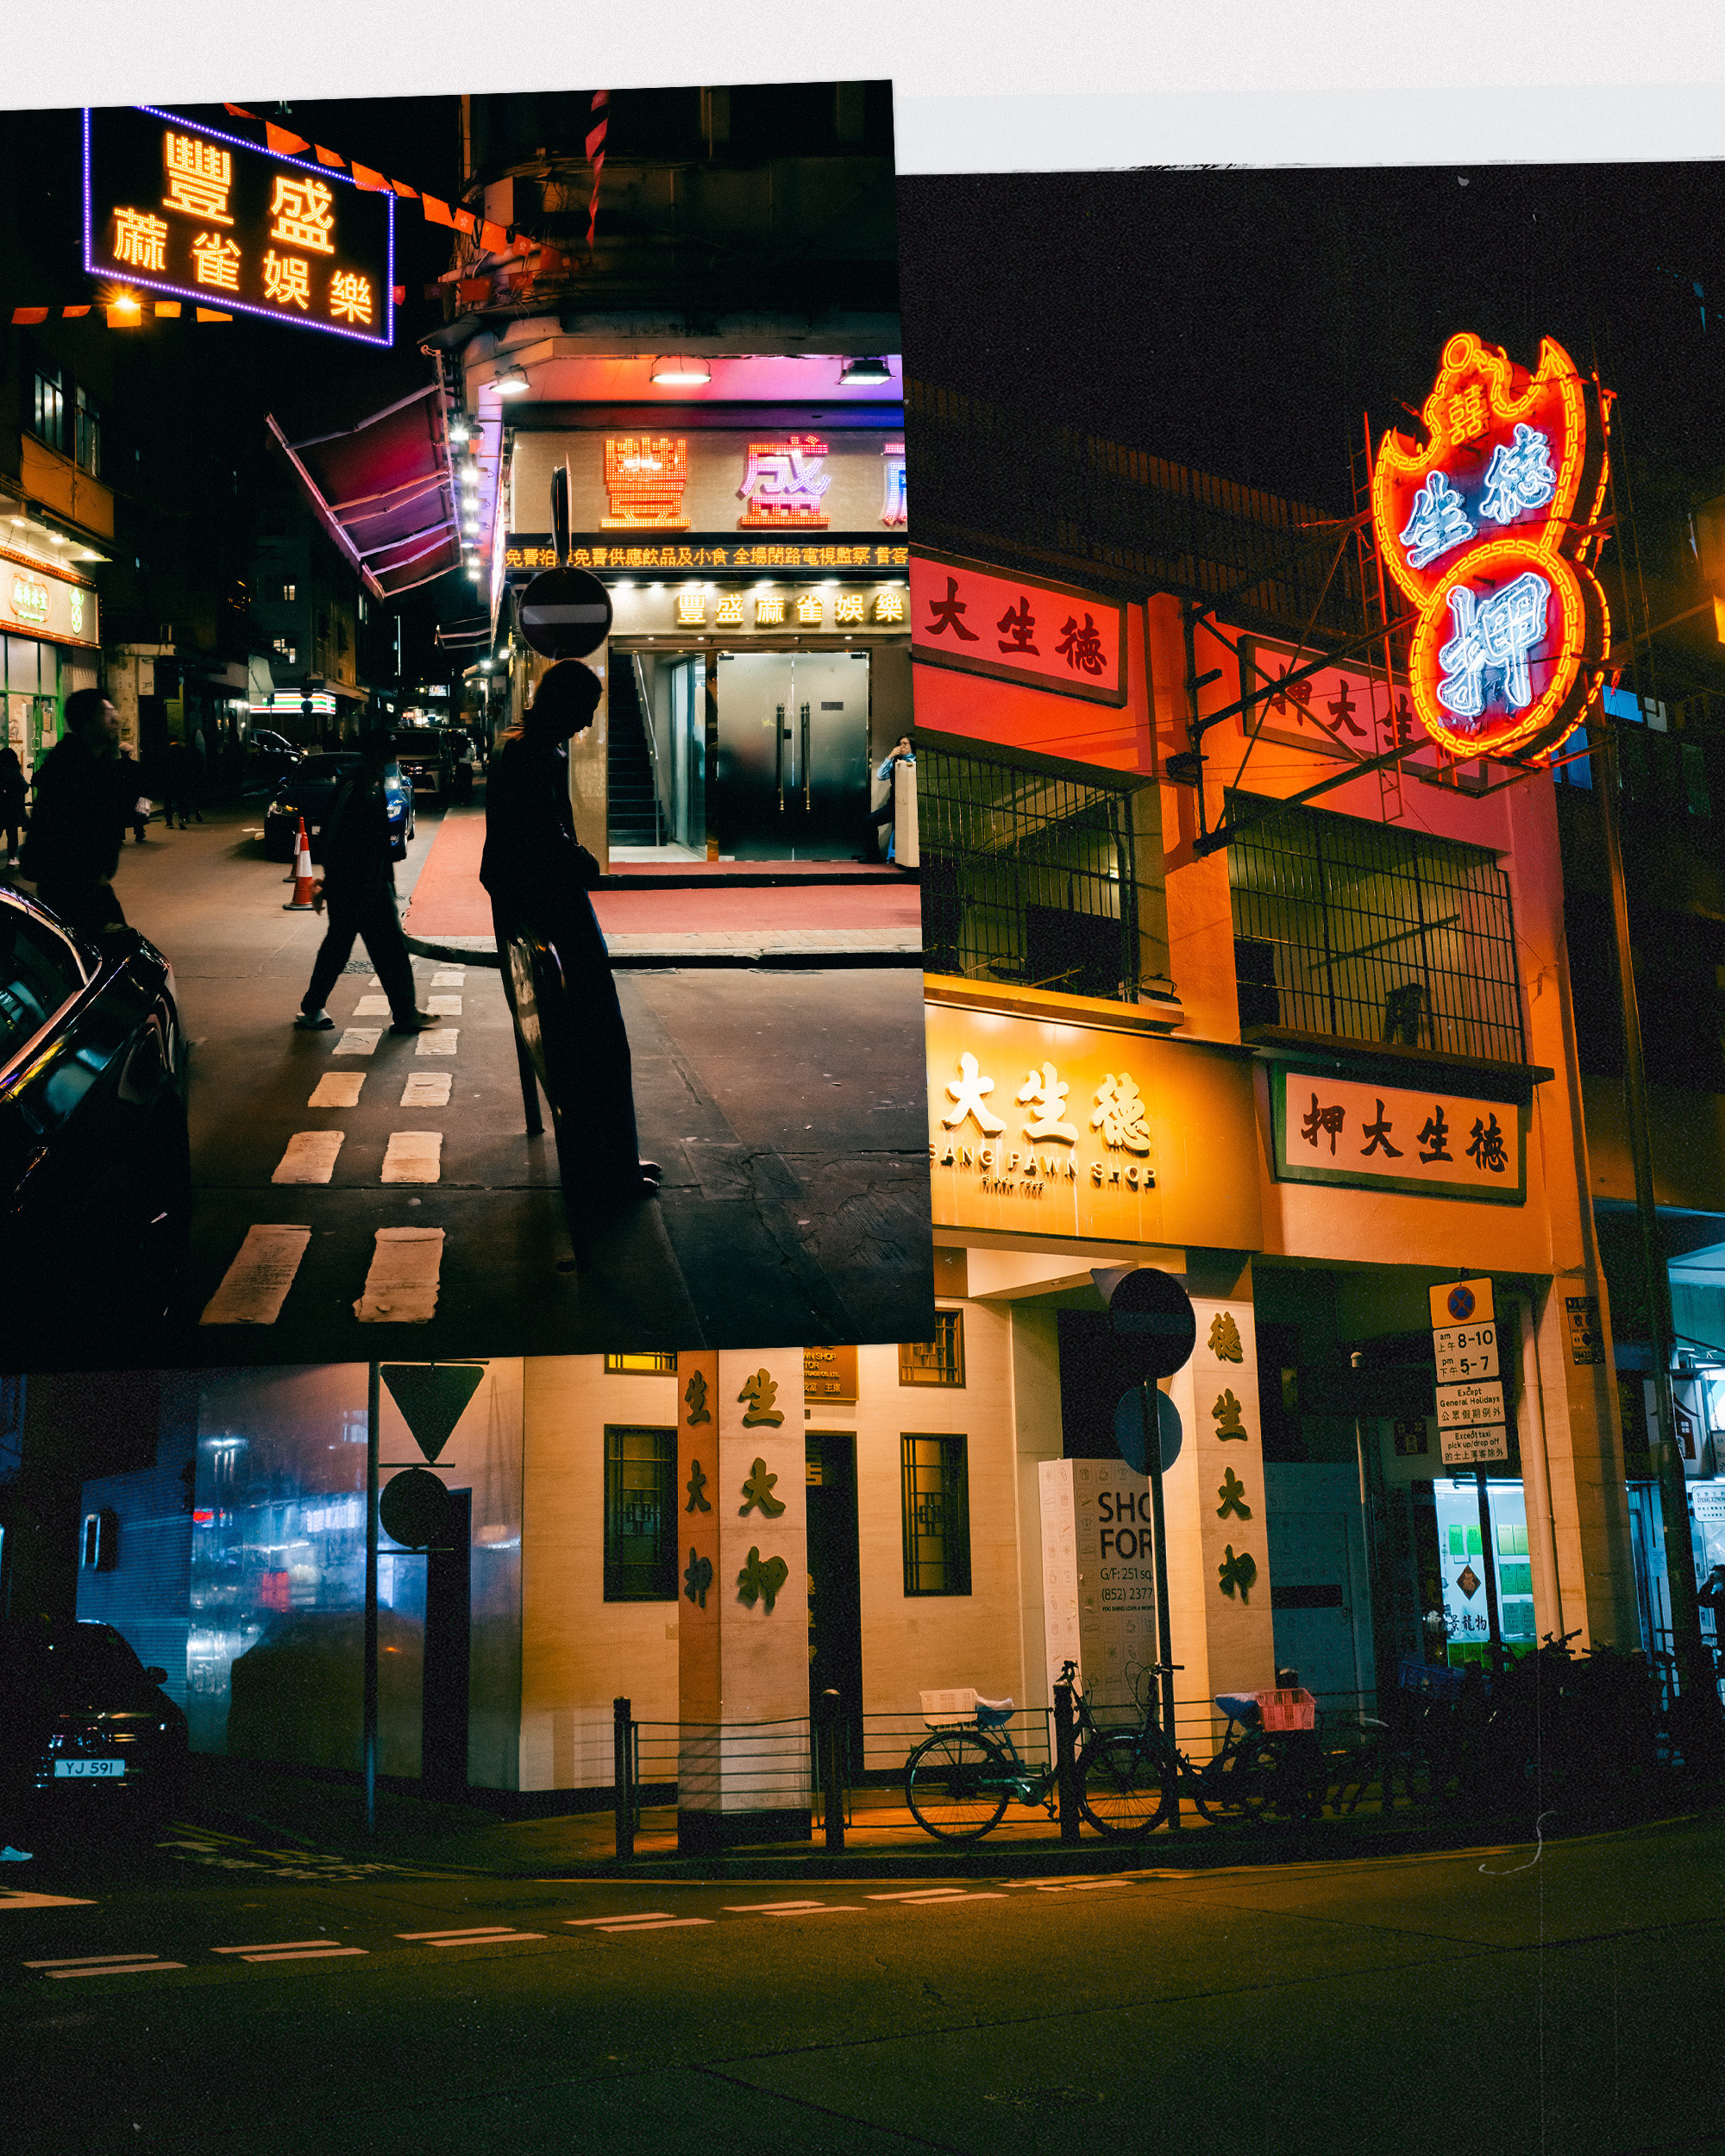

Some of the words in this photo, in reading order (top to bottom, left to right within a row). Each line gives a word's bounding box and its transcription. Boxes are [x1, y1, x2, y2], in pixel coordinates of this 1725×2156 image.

[1007, 1150, 1078, 1176] PAWN
[1090, 1162, 1157, 1185] SHOP
[1458, 1329, 1493, 1348] 8-10
[1438, 1342, 1455, 1353] 上午
[815, 1352, 837, 1361] SHOP
[1442, 1358, 1453, 1367] pm
[1460, 1356, 1489, 1374] 5-7
[1440, 1367, 1458, 1377] 下午
[1458, 1388, 1482, 1397] Except
[1440, 1399, 1468, 1407] General
[1470, 1396, 1500, 1406] Holidays
[1455, 1431, 1479, 1440] Except
[1448, 1440, 1461, 1450] pick
[1463, 1439, 1489, 1449] up/drop
[1208, 1310, 1258, 1607] 德生大押
[684, 1369, 713, 1609] 生大押
[737, 1367, 789, 1617] 生大押
[1100, 1527, 1152, 1559] FOR
[1100, 1567, 1120, 1580] G/F:
[1122, 1568, 1138, 1580] 251
[1101, 1587, 1126, 1602] (852)
[1129, 1587, 1153, 1600] 2377
[66, 1762, 85, 1774] YJ
[90, 1762, 113, 1774] 591
